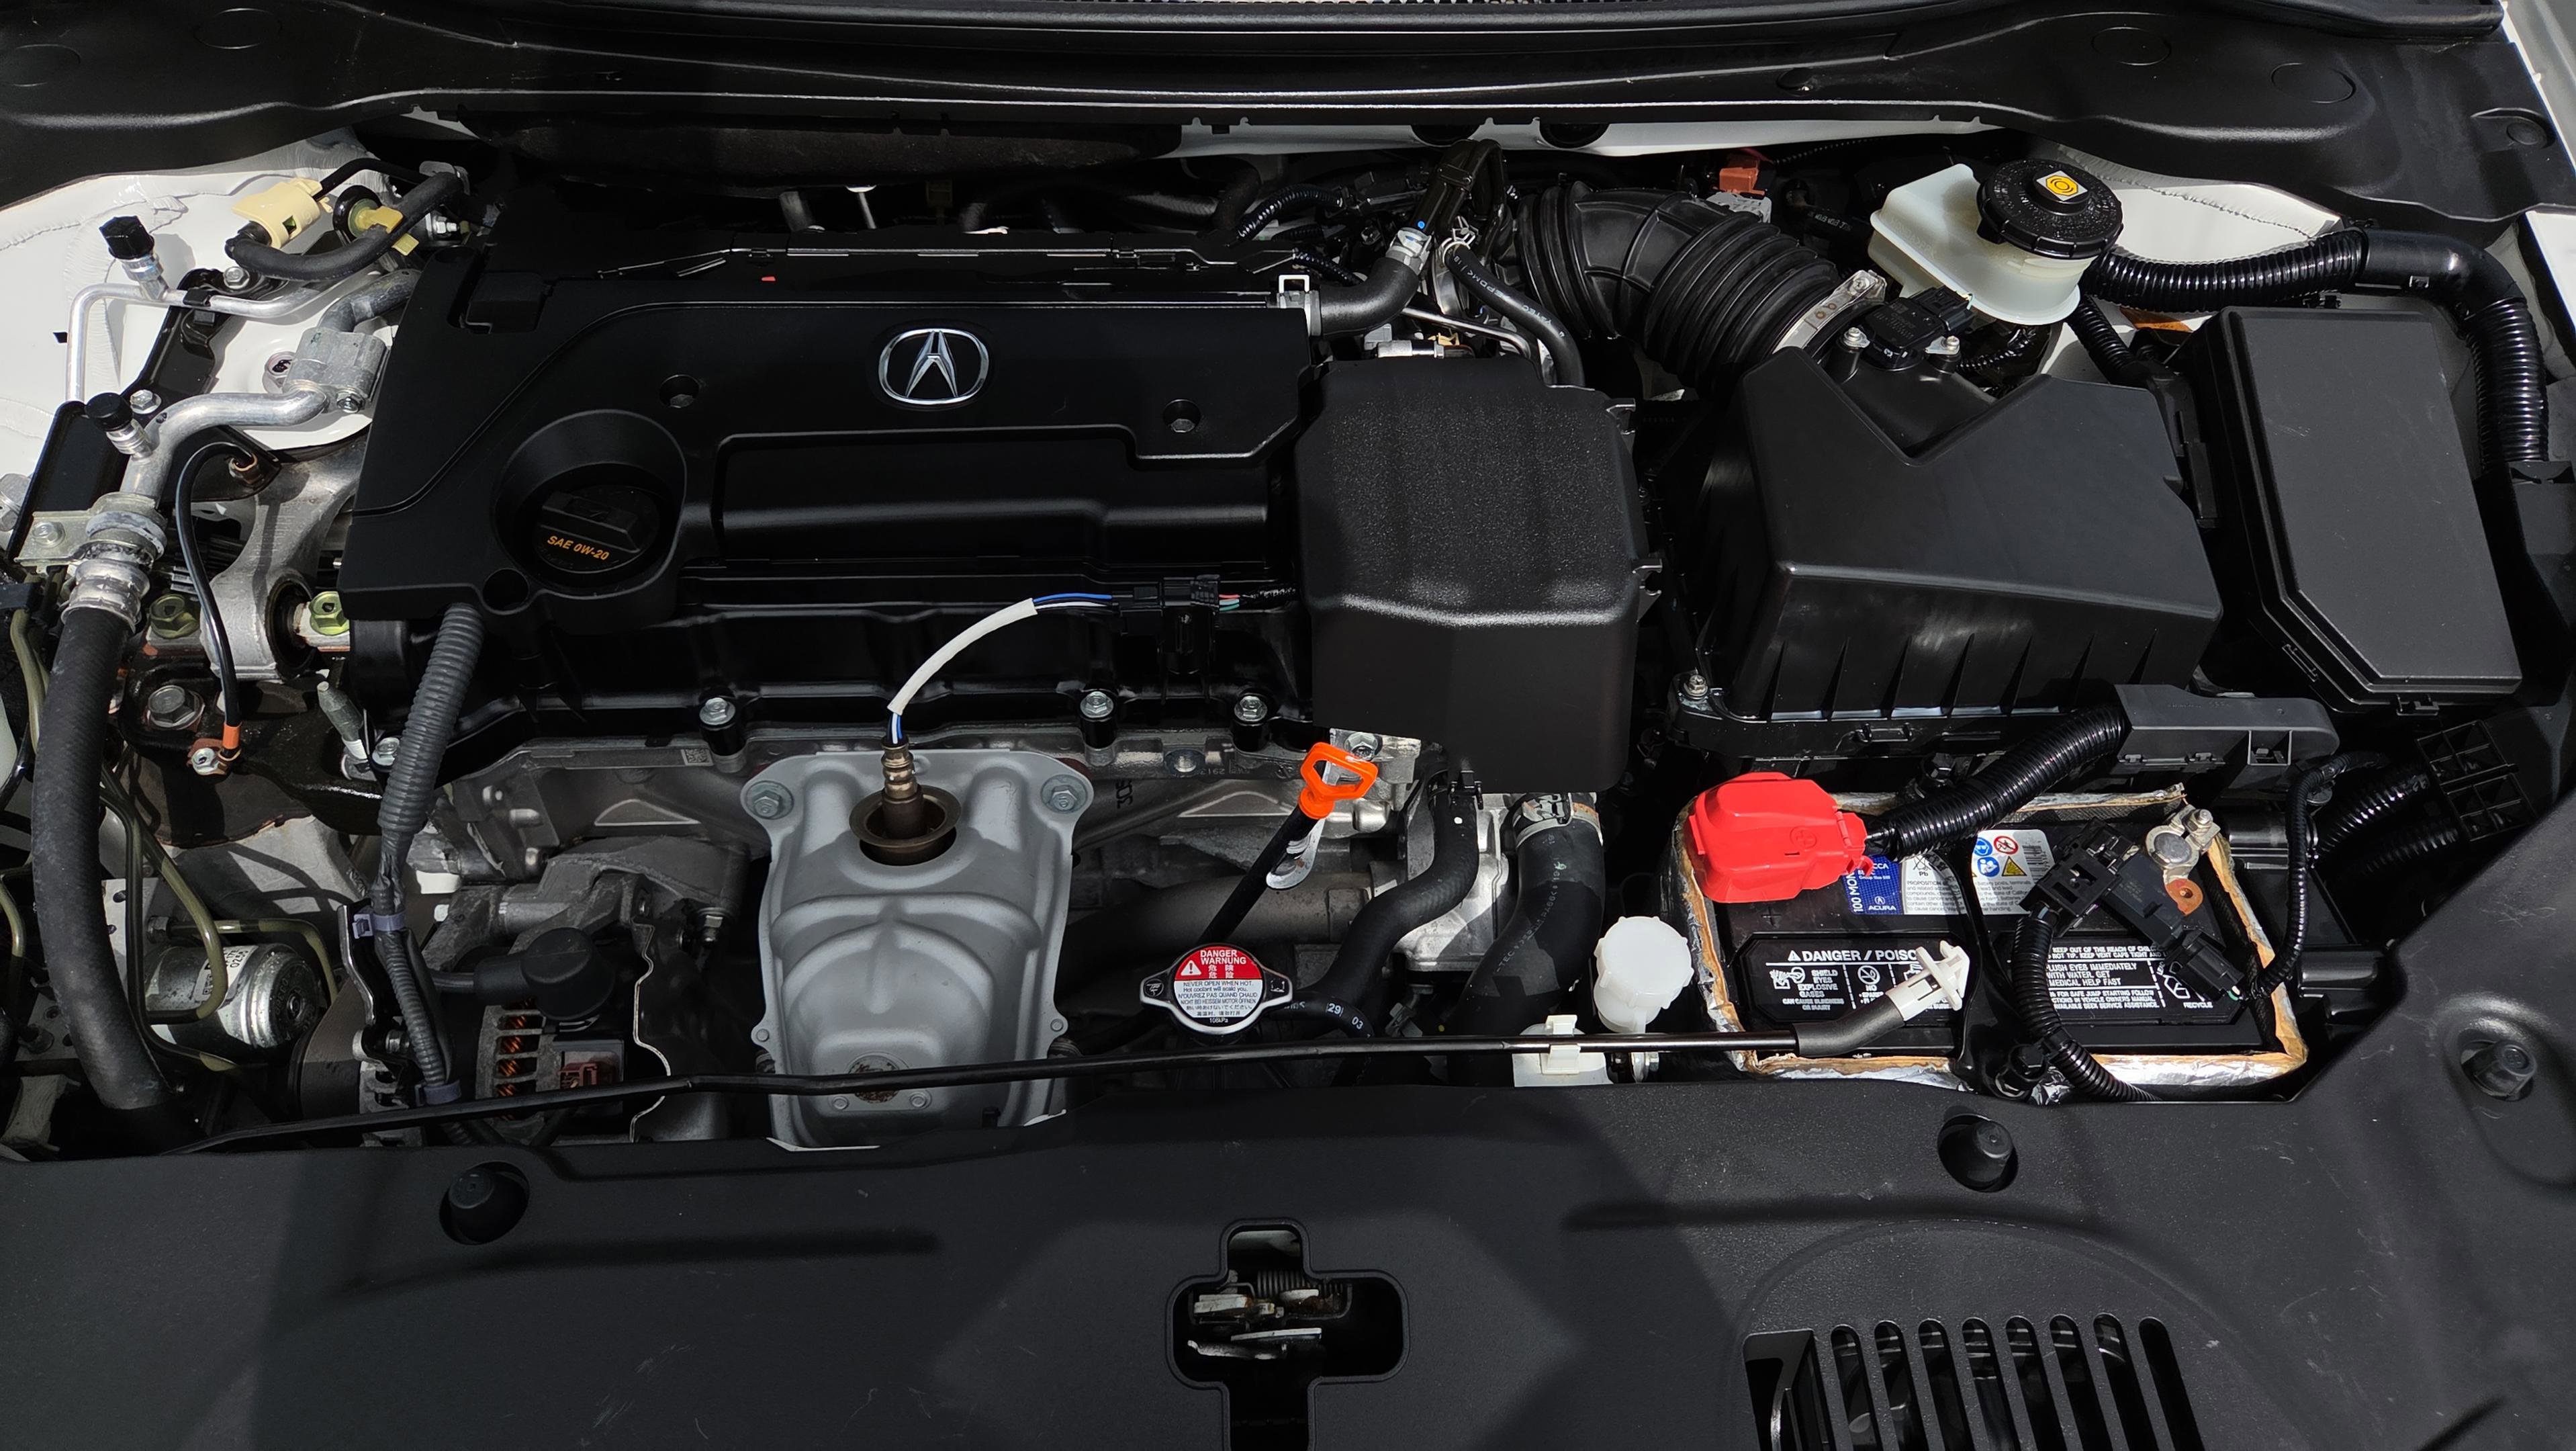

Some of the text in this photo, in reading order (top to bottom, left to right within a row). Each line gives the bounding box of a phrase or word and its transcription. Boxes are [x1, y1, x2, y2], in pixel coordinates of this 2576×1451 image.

[547, 535, 573, 549] SAE
[573, 543, 610, 561] 0W-20
[1851, 897, 1864, 912] 100
[1802, 950, 1861, 961] DANGER
[1864, 950, 1872, 961] /
[2069, 963, 2088, 971] EYES
[2090, 963, 2137, 971] IMMEDIATELY
[2049, 979, 2081, 987] MEDICAL
